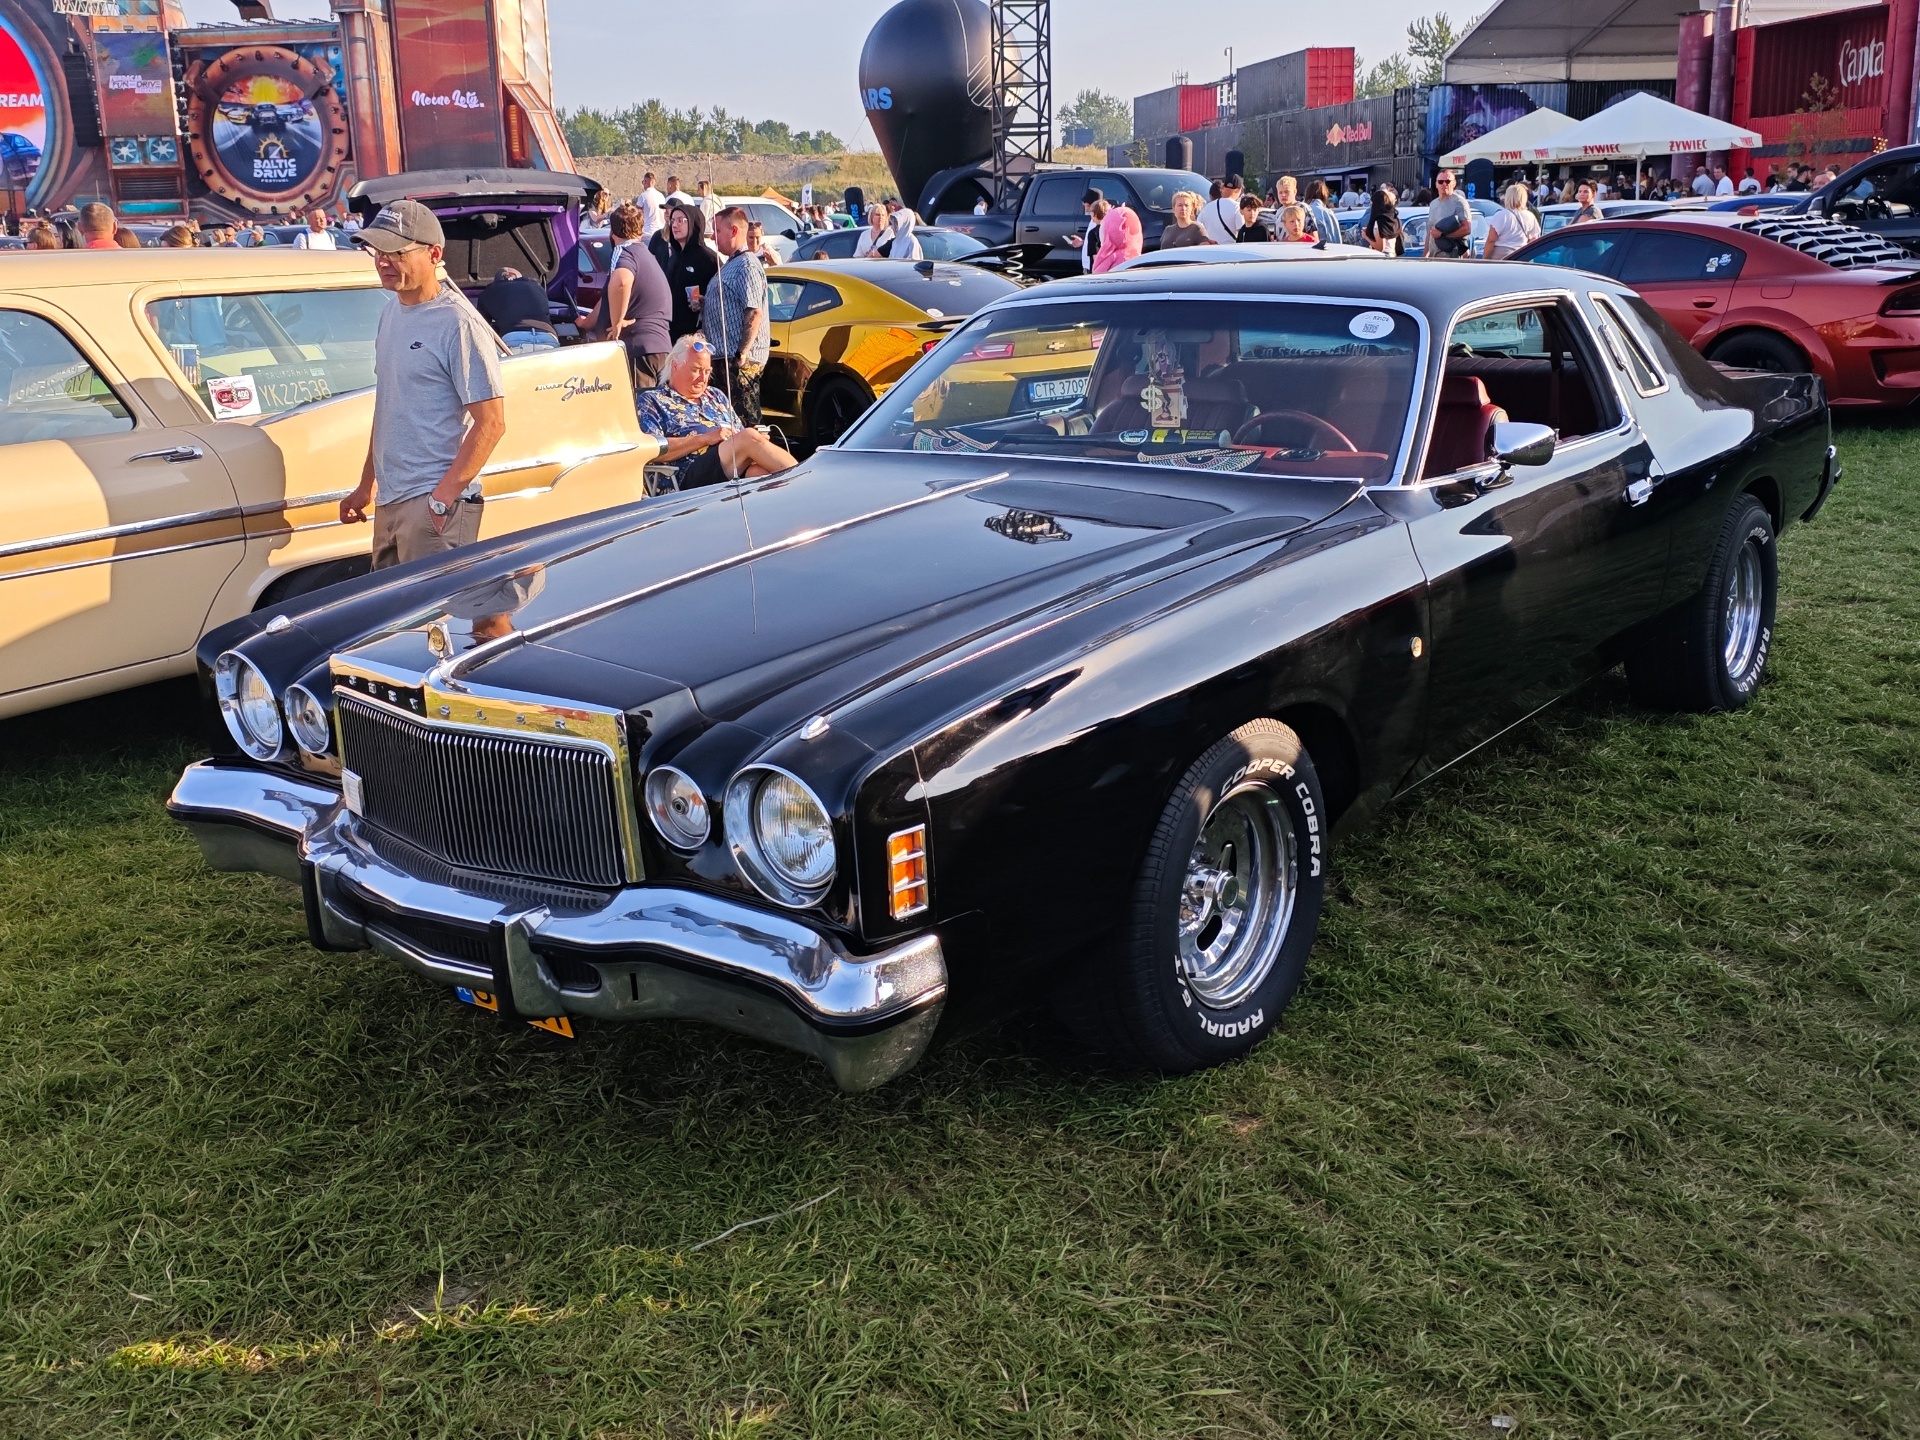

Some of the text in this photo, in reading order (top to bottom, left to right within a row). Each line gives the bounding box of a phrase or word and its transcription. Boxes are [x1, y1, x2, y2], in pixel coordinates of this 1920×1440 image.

[1839, 37, 1884, 87] Capta
[1346, 121, 1372, 142] Red Bull
[253, 158, 297, 169] BALTIC
[253, 168, 297, 178] DRIVE
[265, 368, 309, 380] CALIFORNIA
[258, 379, 332, 407] YK22538
[1035, 382, 1056, 397] CTR
[1220, 757, 1320, 877] COOPER COBRA
[1198, 1008, 1264, 1038] RADIAL
